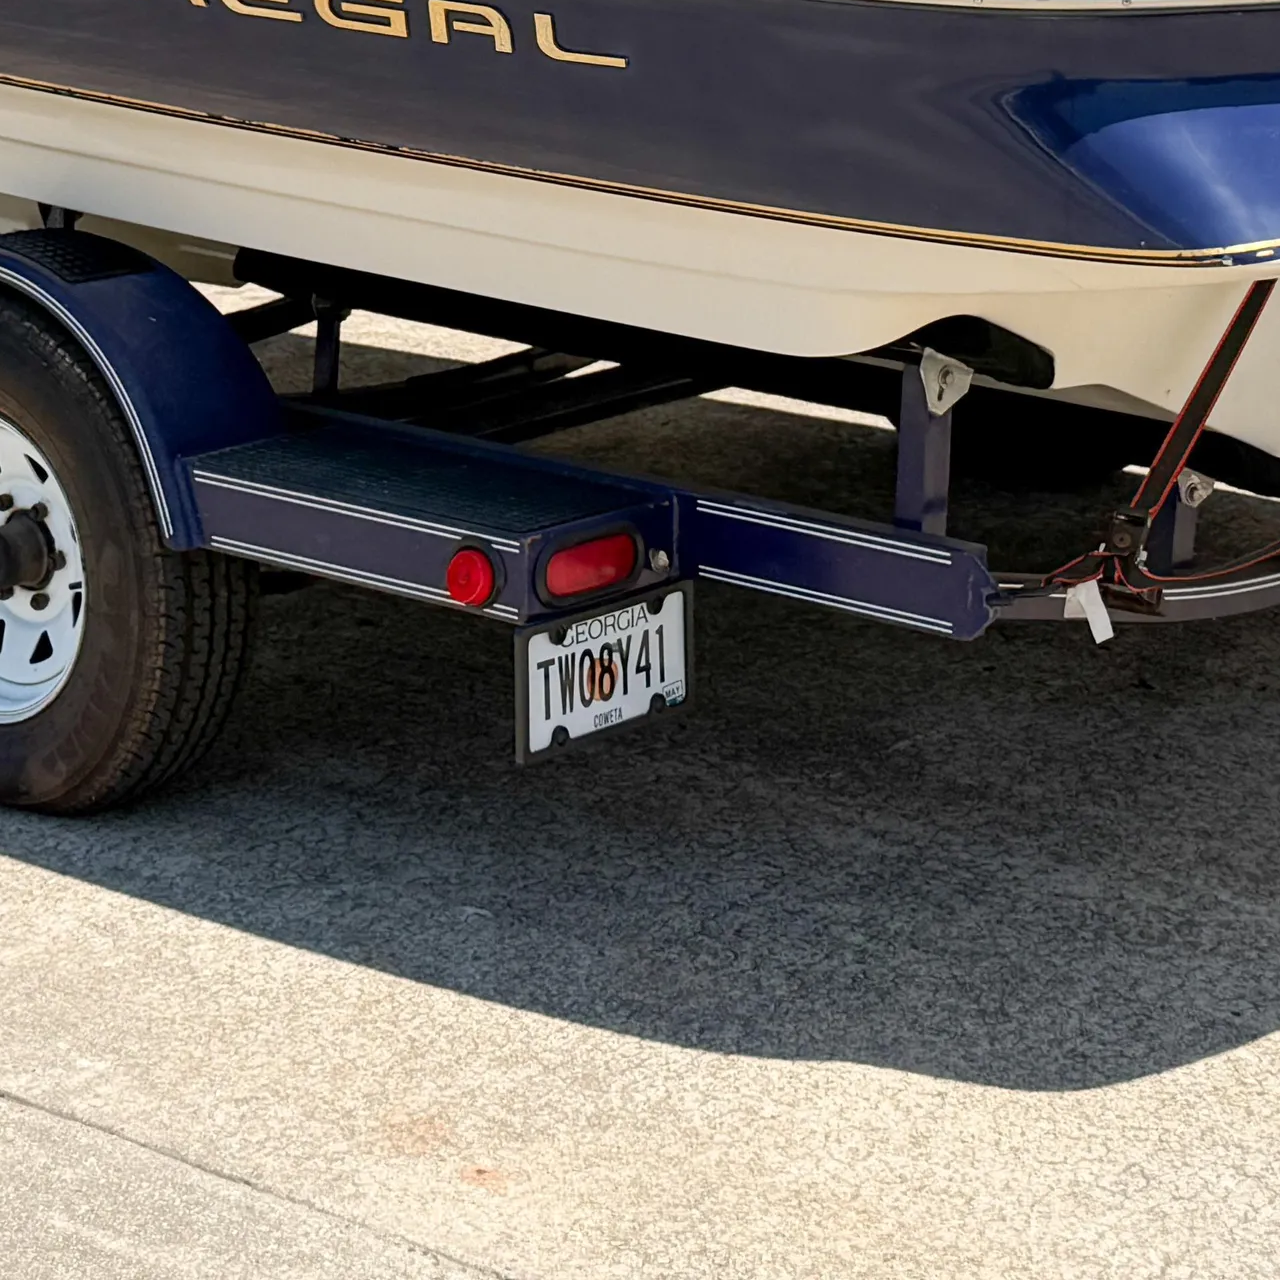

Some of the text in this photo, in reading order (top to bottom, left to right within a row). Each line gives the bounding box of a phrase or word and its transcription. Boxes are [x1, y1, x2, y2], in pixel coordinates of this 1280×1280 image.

[560, 605, 649, 648] GEORGIA
[664, 685, 680, 699] MAY
[593, 707, 623, 729] COWETA
